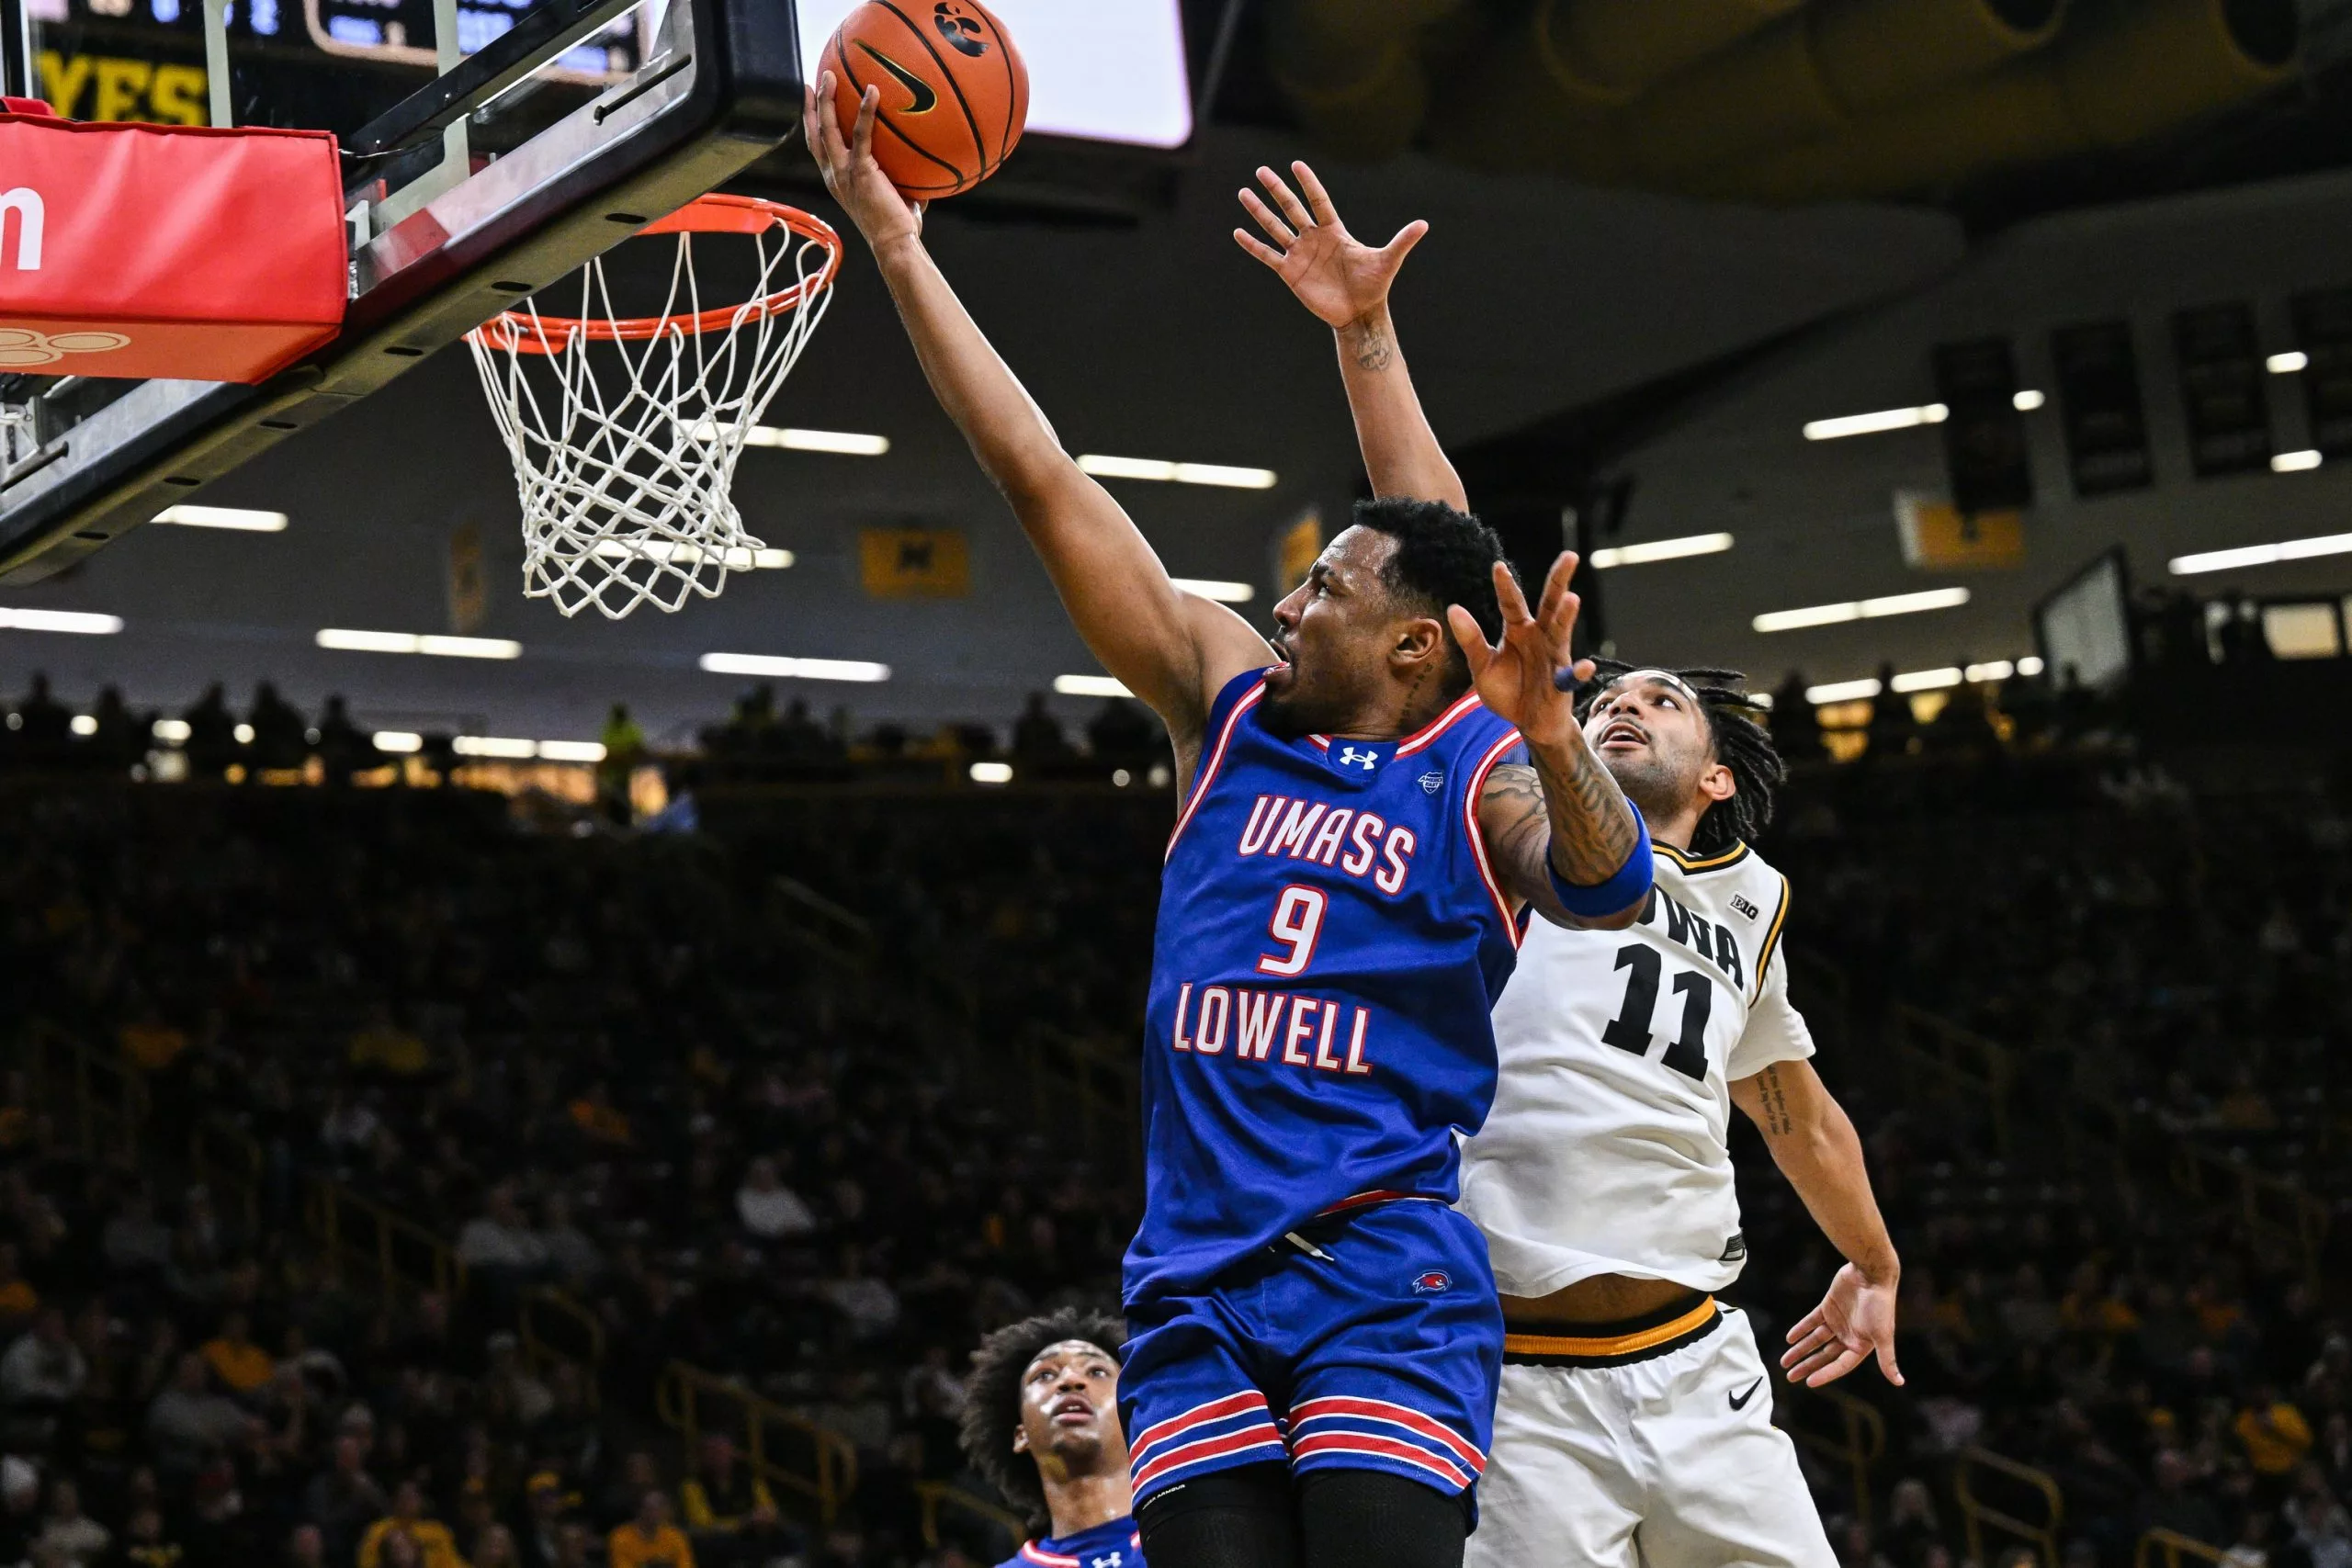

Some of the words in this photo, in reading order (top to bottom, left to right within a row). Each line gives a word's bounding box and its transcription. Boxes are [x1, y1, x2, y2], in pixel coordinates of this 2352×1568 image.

[1238, 795, 1417, 896] UMASS
[1255, 883, 1329, 978] 9
[1636, 882, 1744, 991] WA
[1172, 983, 1374, 1077] LOWELL
[1600, 942, 1713, 1082] 11
